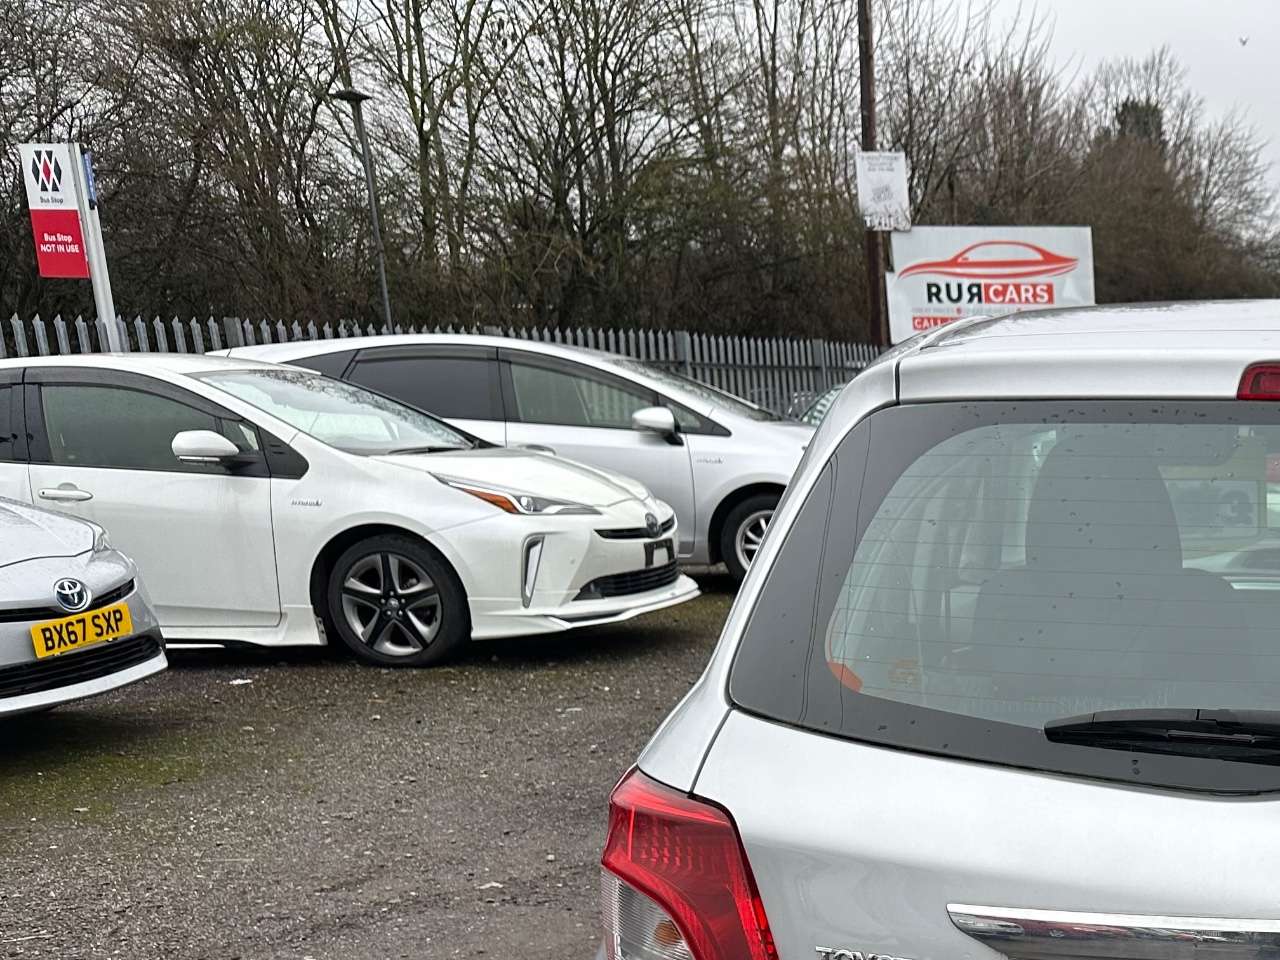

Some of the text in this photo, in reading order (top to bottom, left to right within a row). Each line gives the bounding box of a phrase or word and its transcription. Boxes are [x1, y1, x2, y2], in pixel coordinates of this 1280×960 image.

[44, 232, 73, 242] Bus Stop
[40, 243, 79, 253] NOT IN USE
[988, 285, 1050, 303] CARS
[41, 609, 123, 652] BX67 SXP
